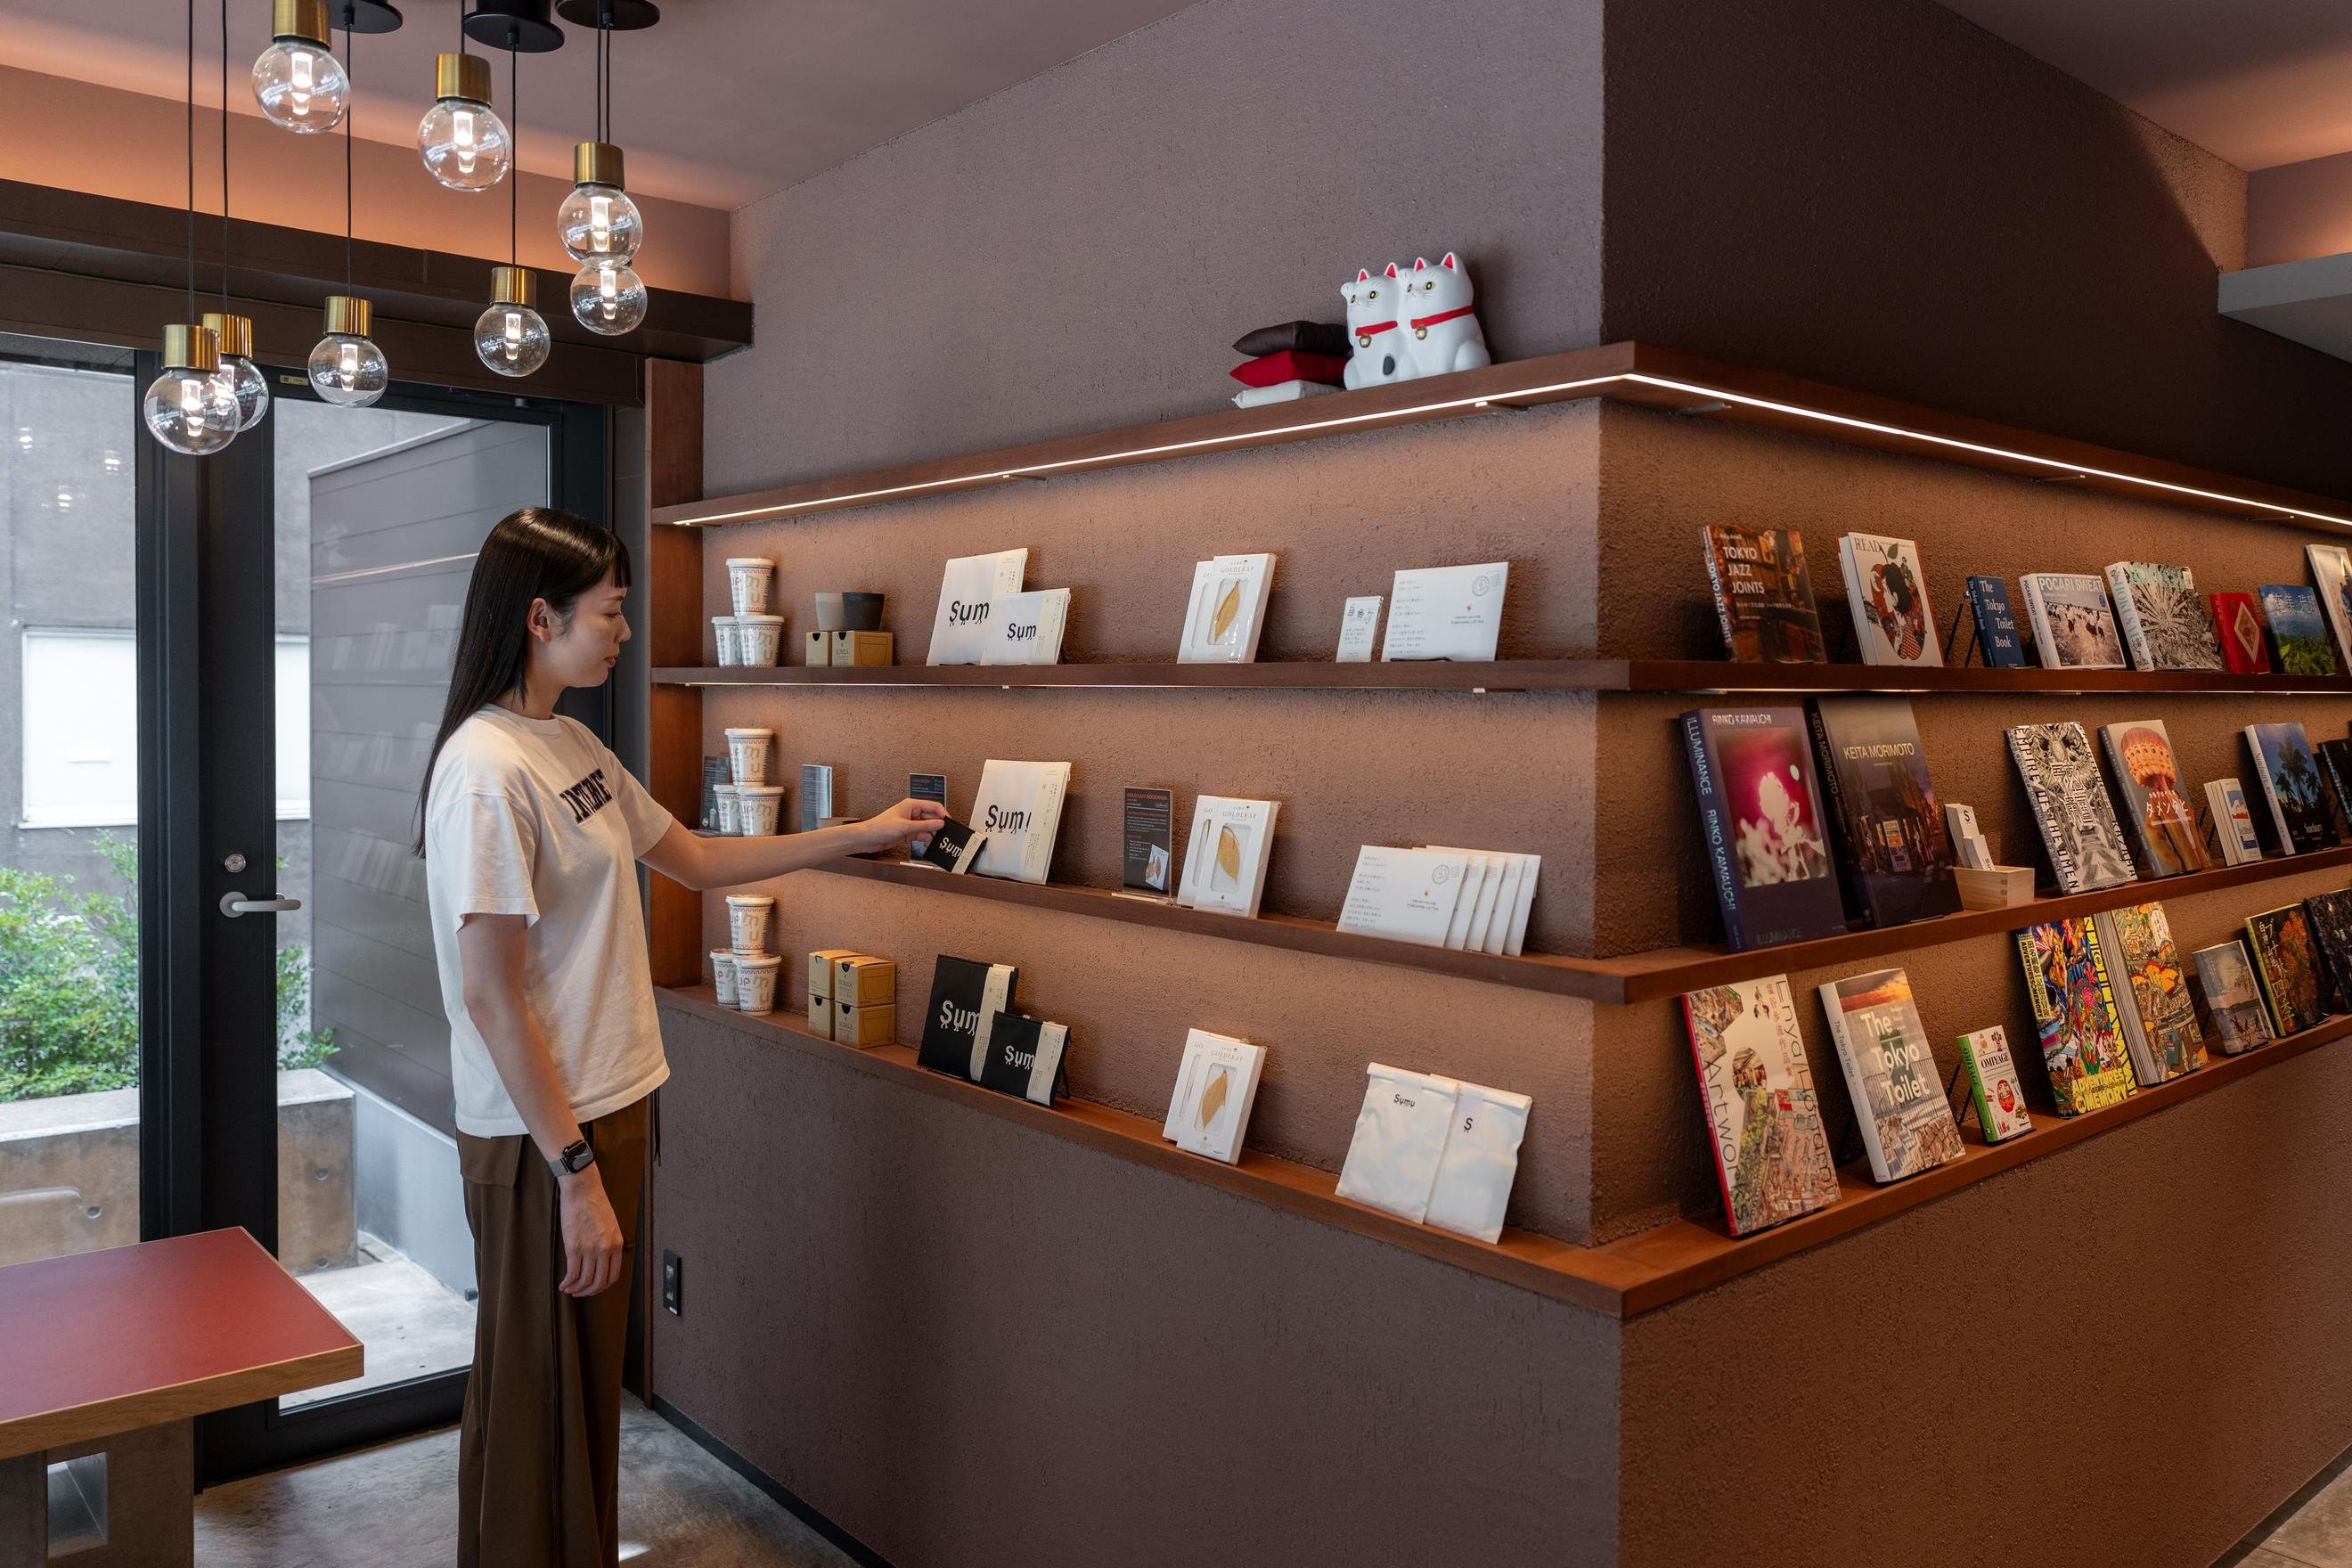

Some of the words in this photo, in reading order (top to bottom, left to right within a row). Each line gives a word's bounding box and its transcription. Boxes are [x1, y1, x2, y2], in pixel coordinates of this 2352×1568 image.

[1722, 546, 1758, 560] TOKYO
[1708, 561, 1720, 591] TOKYO
[1728, 564, 1752, 576] JAZZ
[1732, 581, 1765, 595] JOINTS
[1979, 580, 1994, 592] The
[2039, 577, 2074, 592] POCARI
[2076, 579, 2103, 593] SWEAT
[1714, 592, 1727, 614] JAZZ
[1985, 599, 2006, 614] Tokyo
[1719, 614, 1733, 643] JOINTS
[1995, 617, 2015, 631] Toilet
[1994, 635, 2013, 649] Book
[1711, 714, 1735, 726] RINKO
[1735, 713, 1772, 725] KAWAUCHI
[1810, 712, 1823, 739] KEITA
[1819, 740, 1840, 795] MORIMOTO
[1843, 746, 1868, 760] KEITA
[1869, 743, 1915, 758] MORIMOTO
[1686, 717, 1712, 796] ILLUMINANCE
[1706, 808, 1721, 845] RINKO
[1714, 845, 1736, 911] KAWAUCHI
[2014, 728, 2040, 783] EMPIRE
[2038, 790, 2049, 809] OF
[2046, 816, 2063, 844] THE
[2057, 849, 2080, 890] OMEN
[2020, 941, 2036, 984] ADVENTURES
[2031, 989, 2044, 1018] MEMORY
[1775, 979, 1803, 1058] Enya
[1860, 1011, 1893, 1037] The
[1833, 1020, 1842, 1033] The
[1838, 1034, 1849, 1058] Tokyo
[1844, 1058, 1856, 1079] Toilet
[1871, 1041, 1920, 1073] Tokyo
[1980, 1051, 2011, 1070] OMIYAGE
[1963, 1048, 1979, 1085] OMIYAGE
[1880, 1072, 1931, 1107] Toilet
[2071, 1067, 2124, 1094] ADVENTURES
[1393, 1093, 1416, 1108] Sumu
[2086, 1086, 2128, 1112] MEMORY
[1464, 1117, 1474, 1132] S
[1703, 1059, 1744, 1221] Artworks
